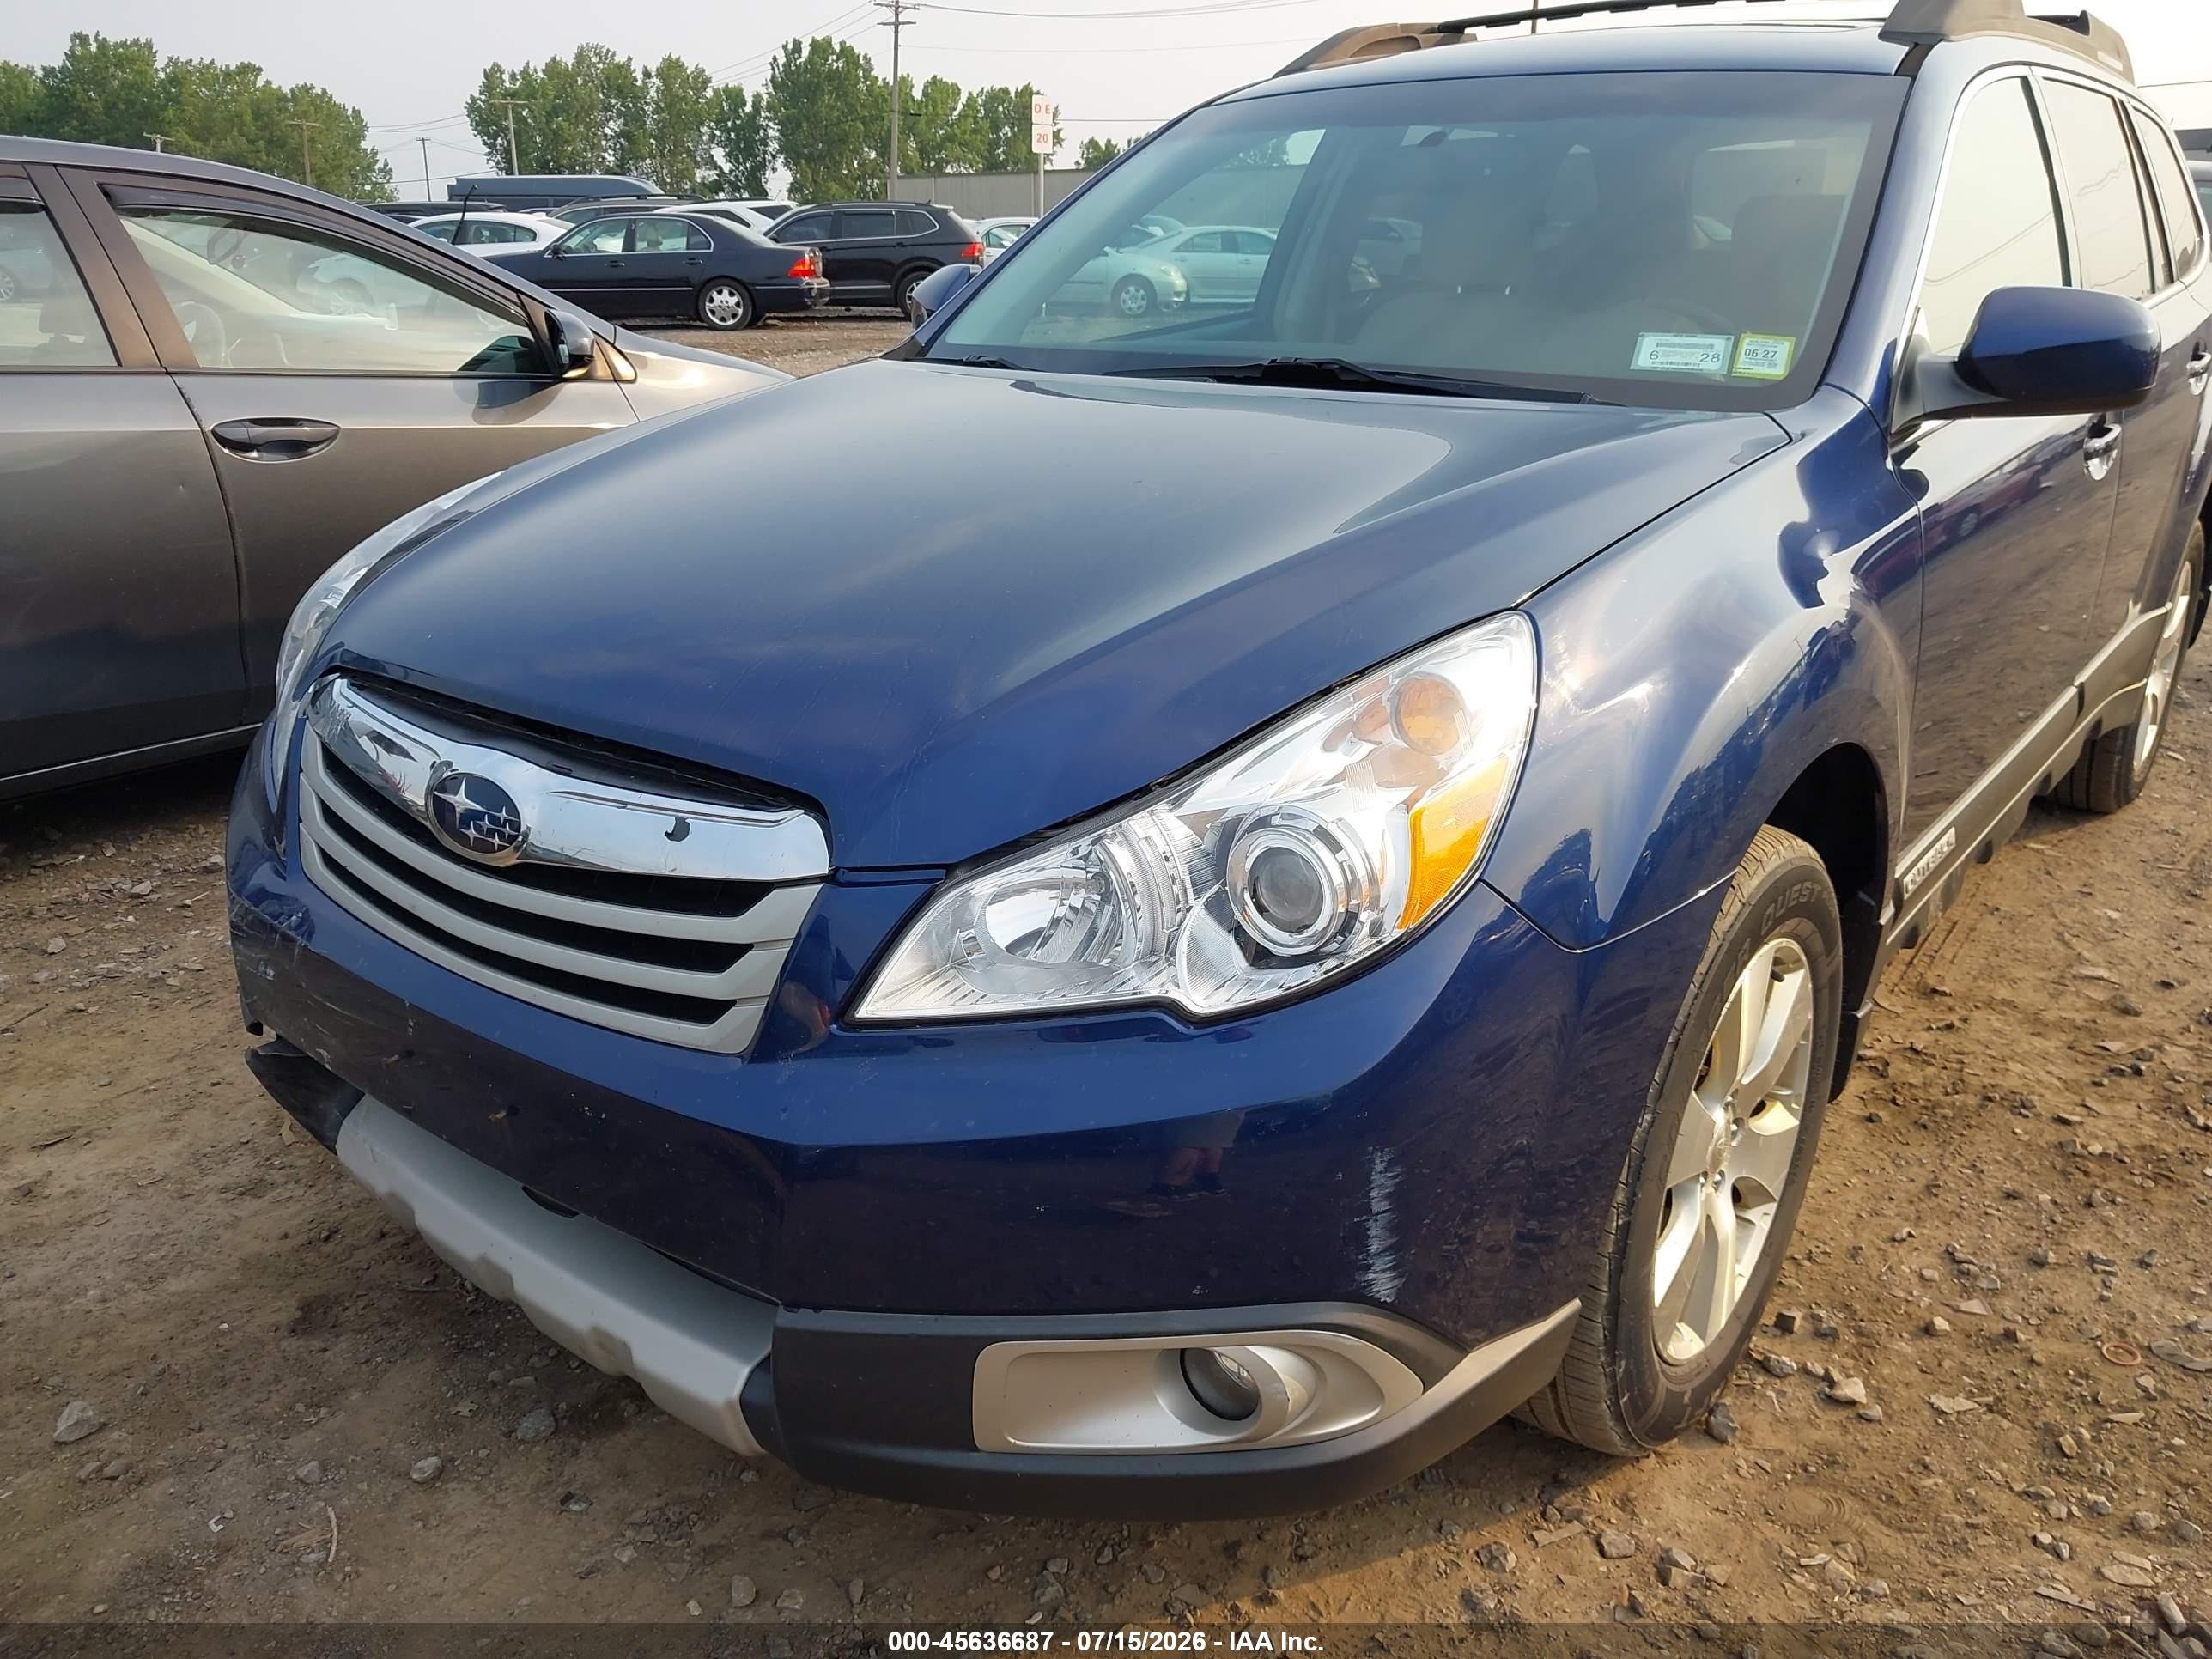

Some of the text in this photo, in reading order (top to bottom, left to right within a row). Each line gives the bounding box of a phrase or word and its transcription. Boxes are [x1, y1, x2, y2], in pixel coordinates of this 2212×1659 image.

[1034, 103, 1051, 114] D E
[1036, 133, 1048, 143] 20
[1649, 349, 1721, 363] 6 28
[1744, 348, 1778, 359] 06 27
